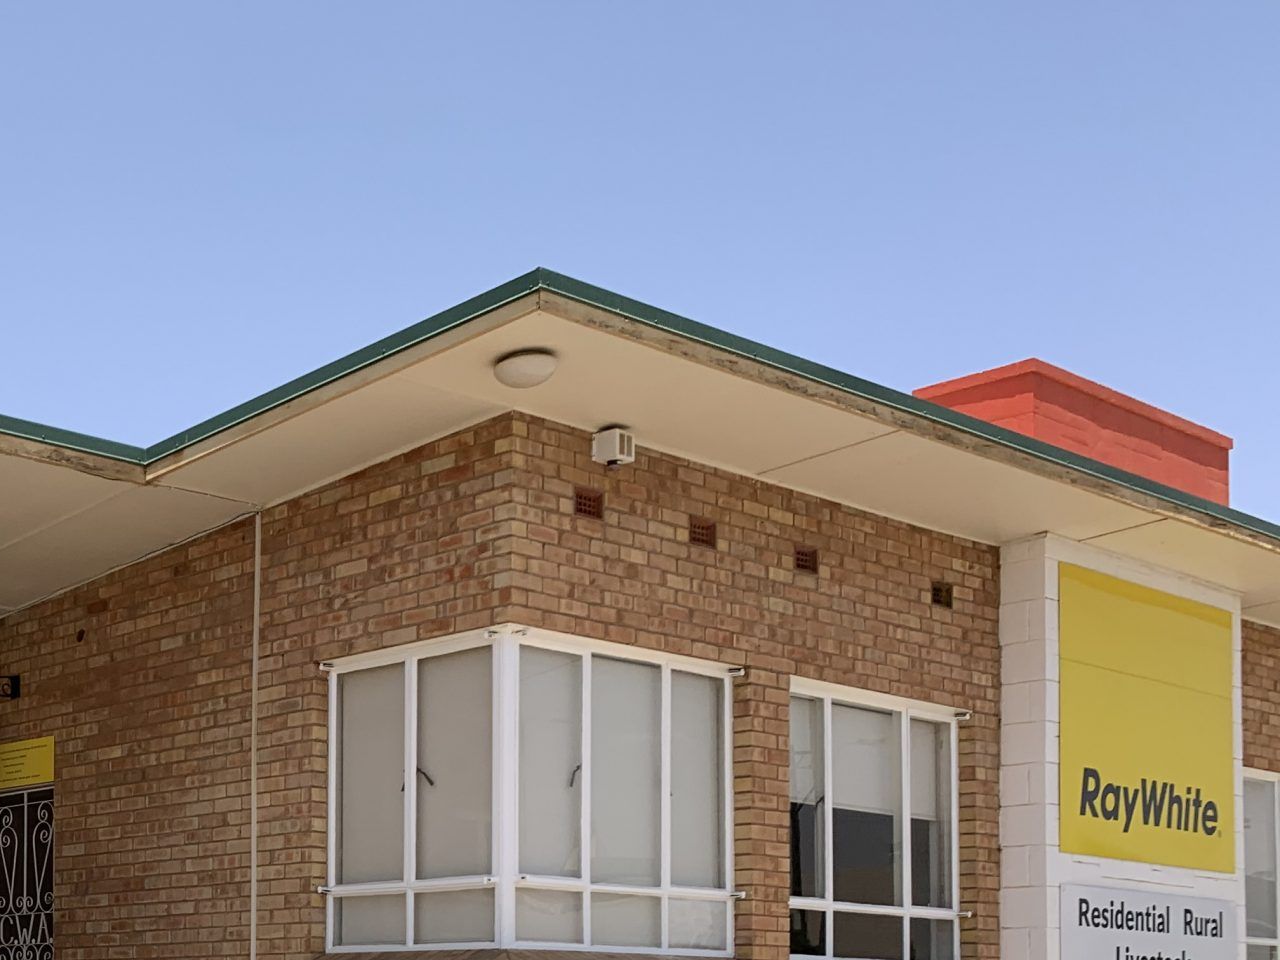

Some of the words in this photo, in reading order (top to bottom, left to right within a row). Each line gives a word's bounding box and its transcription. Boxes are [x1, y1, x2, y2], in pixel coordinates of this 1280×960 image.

[1079, 767, 1219, 836] RayWhite
[1078, 897, 1170, 934] Residential
[1183, 908, 1223, 938] Rural
